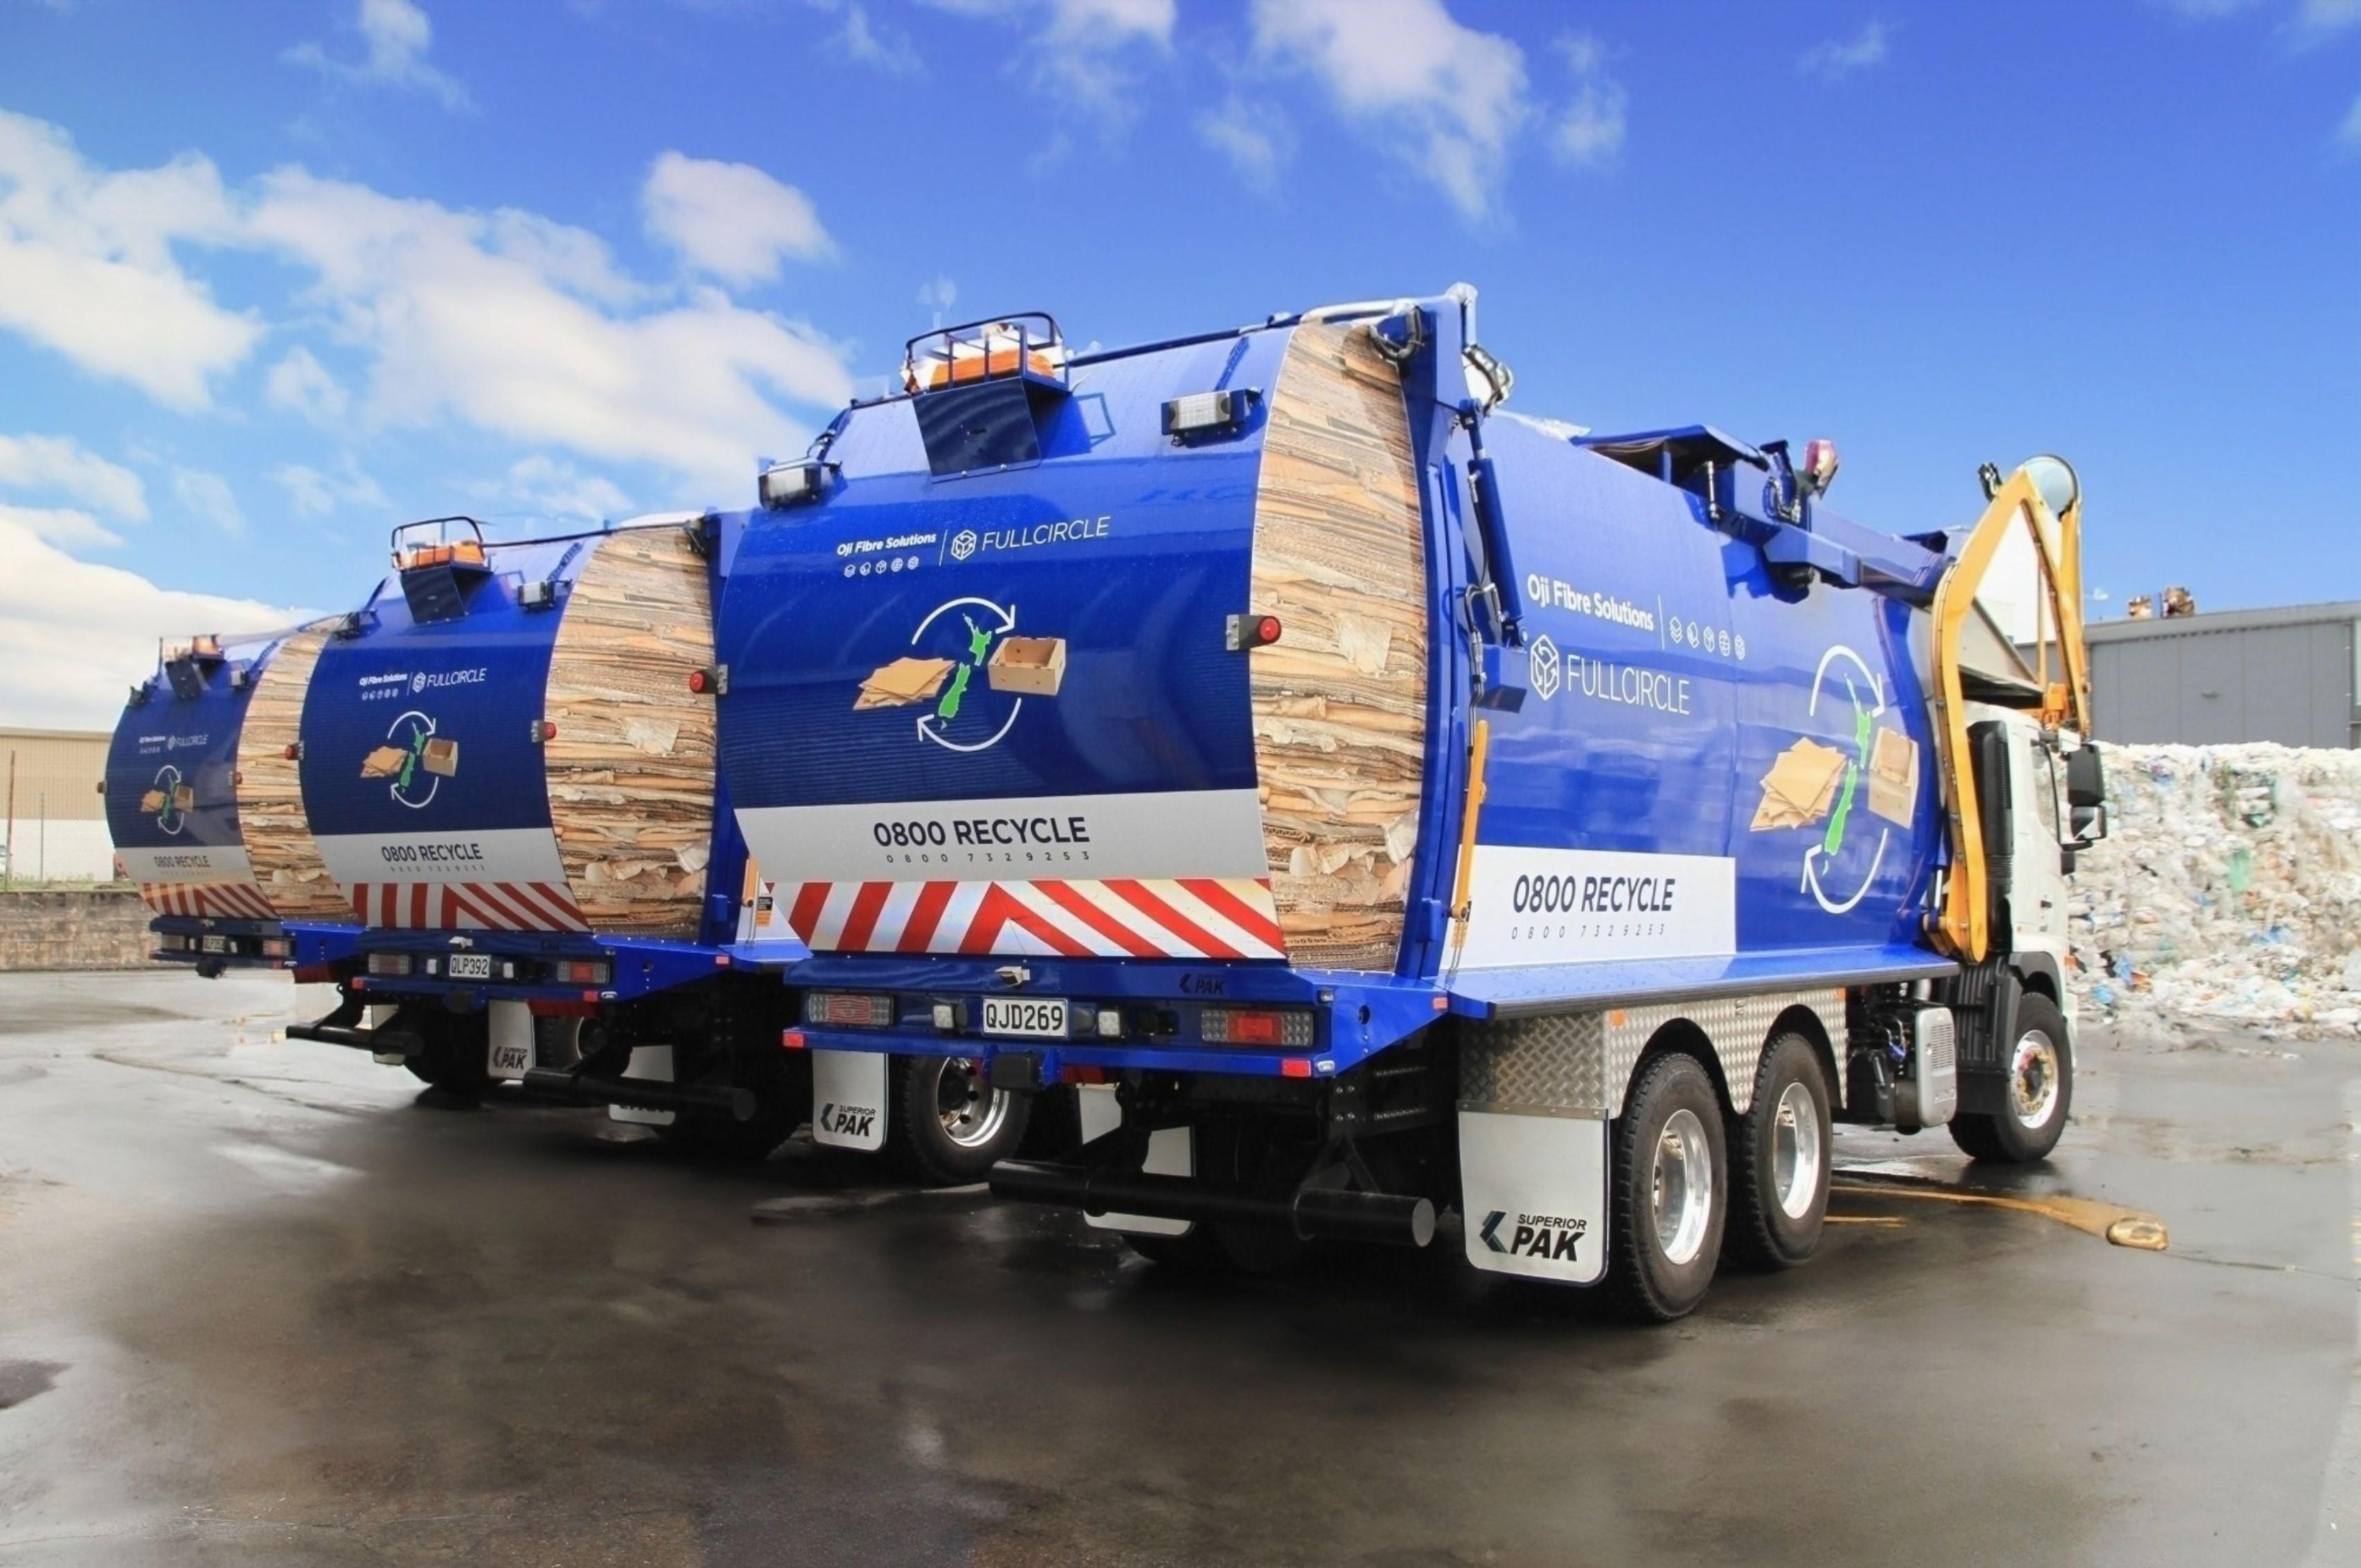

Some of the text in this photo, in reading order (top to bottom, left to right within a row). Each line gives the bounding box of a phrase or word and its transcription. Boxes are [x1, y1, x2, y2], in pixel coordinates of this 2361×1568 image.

[837, 532, 936, 556] Oji Fibre Solutions
[982, 516, 1110, 551] FULLCIRCLE
[1527, 573, 1655, 632] Oji Fibre Solutions
[427, 668, 488, 687] FULLCIRCLE
[1567, 654, 1690, 715] FULLCIRCLE
[873, 817, 1091, 846] 0800 RECYCLE
[382, 844, 483, 862] 0800 RECYCLE
[1513, 874, 1675, 913] 0800 RECYCLE
[451, 958, 488, 975] QLP392
[986, 1004, 1063, 1031] QJD269
[501, 1053, 527, 1070] PAK
[839, 1105, 876, 1116] SUPERIOR
[834, 1113, 875, 1137] PAK
[1517, 1213, 1587, 1231] SUPERIOR
[1510, 1226, 1585, 1262] PAK
